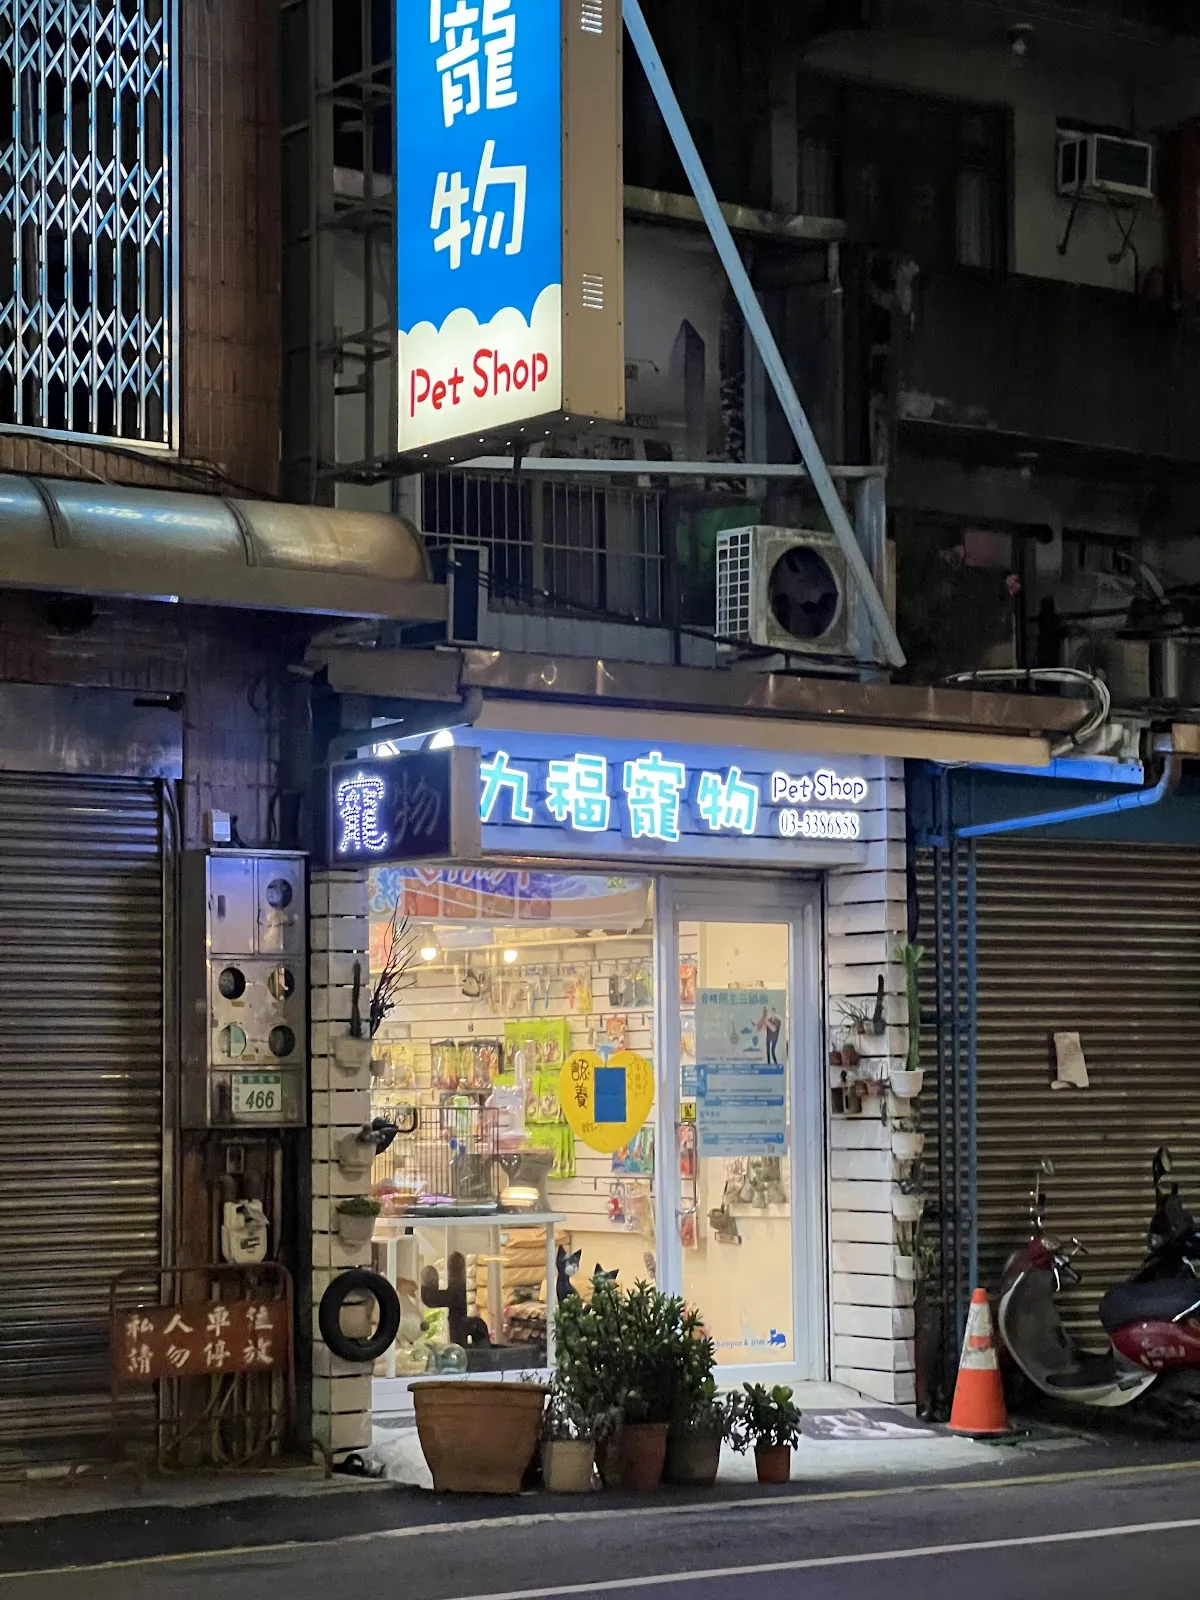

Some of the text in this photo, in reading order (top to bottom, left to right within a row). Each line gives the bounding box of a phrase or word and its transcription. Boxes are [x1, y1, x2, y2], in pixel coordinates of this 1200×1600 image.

[410, 347, 549, 418] Pet Shop
[480, 750, 759, 843] 九福寵物
[773, 771, 865, 802] Pet Shop
[780, 811, 858, 837] 03-3386858
[245, 1090, 275, 1110] 466
[571, 1059, 590, 1109] 認養
[127, 1339, 274, 1375] 請勿停放
